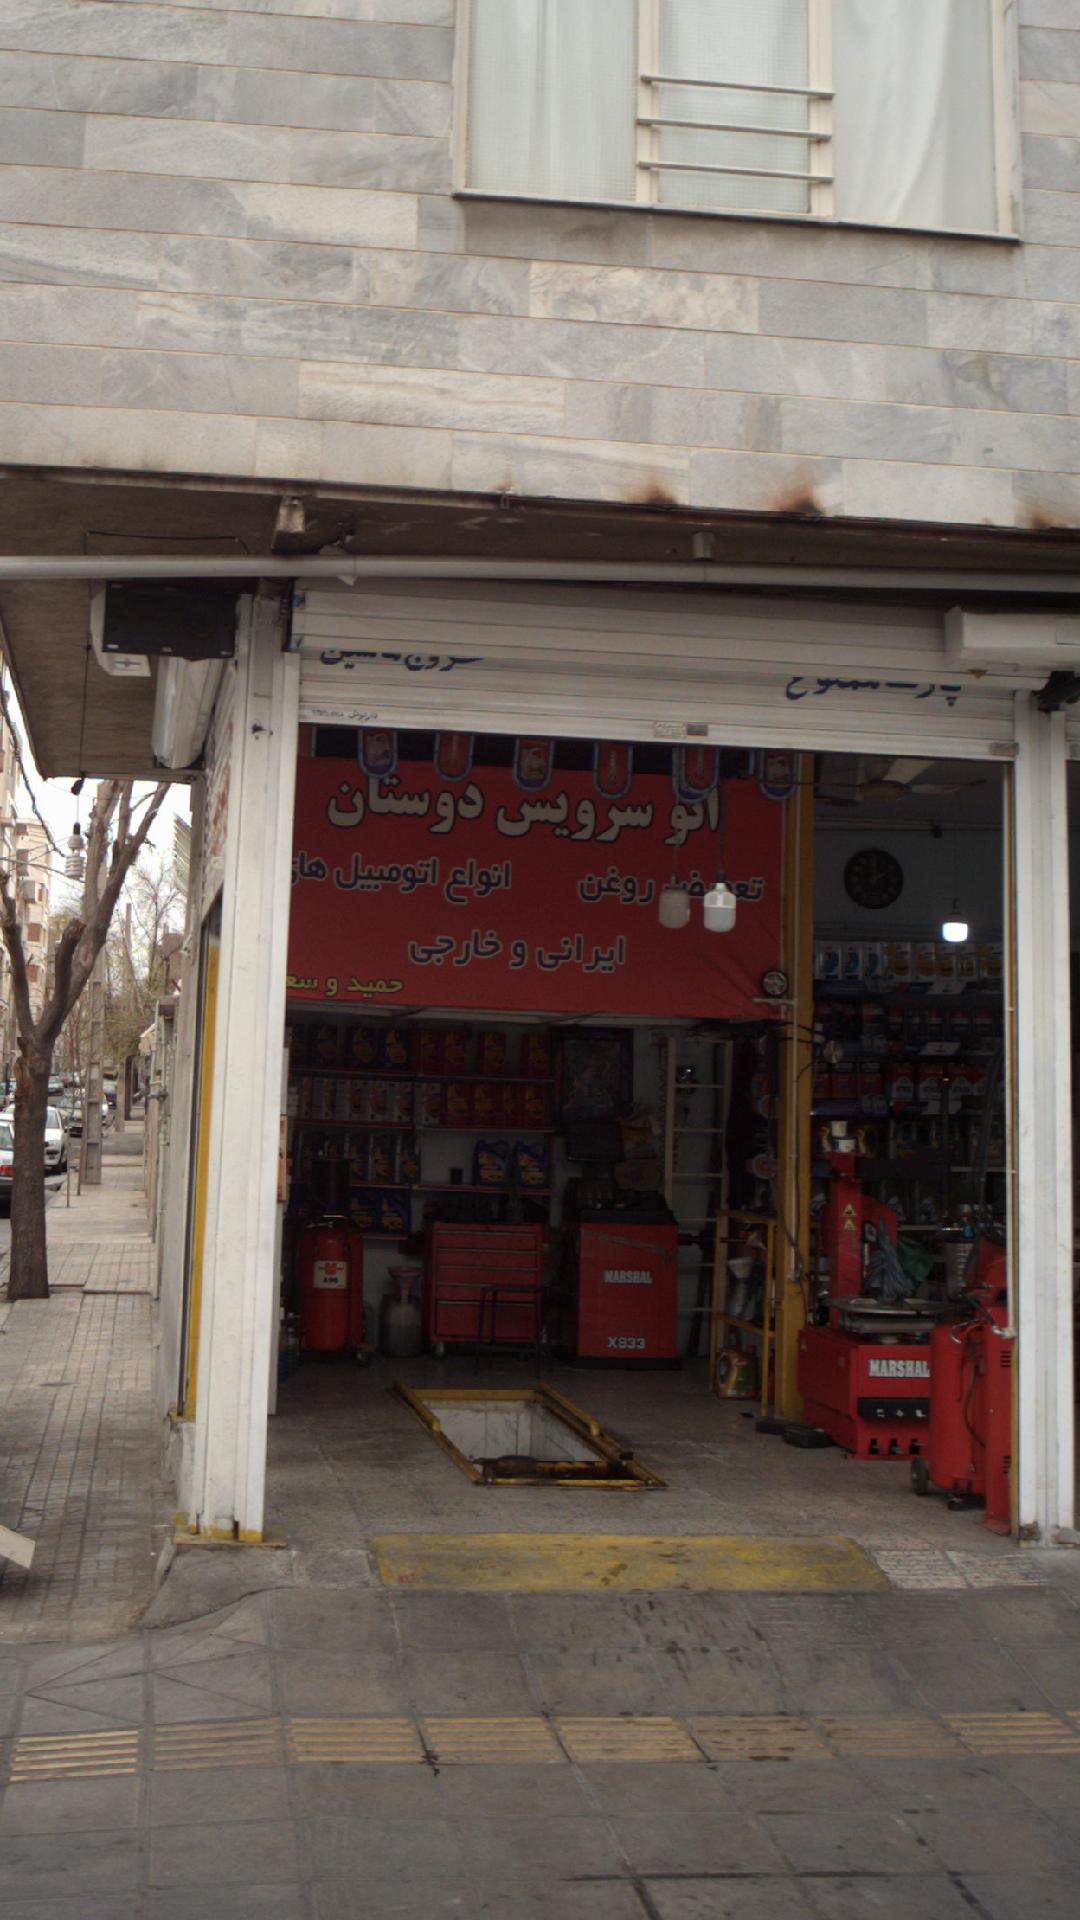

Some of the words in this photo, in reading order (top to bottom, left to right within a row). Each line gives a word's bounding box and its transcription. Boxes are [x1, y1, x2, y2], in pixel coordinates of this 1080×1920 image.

[327, 776, 484, 833] دوستان
[496, 790, 654, 843] سرویس
[336, 854, 438, 892] اتومبیل
[445, 859, 512, 904] انواع
[578, 867, 653, 902] روغن
[660, 870, 765, 902] تعض
[409, 930, 502, 967] خارجی
[509, 938, 529, 970] و
[536, 933, 626, 972] ایرانی
[286, 974, 318, 990] سع
[325, 976, 340, 997] و
[346, 977, 405, 998] حمید
[604, 1270, 653, 1285] MARSHAL
[868, 1358, 931, 1378] MARSHAL
